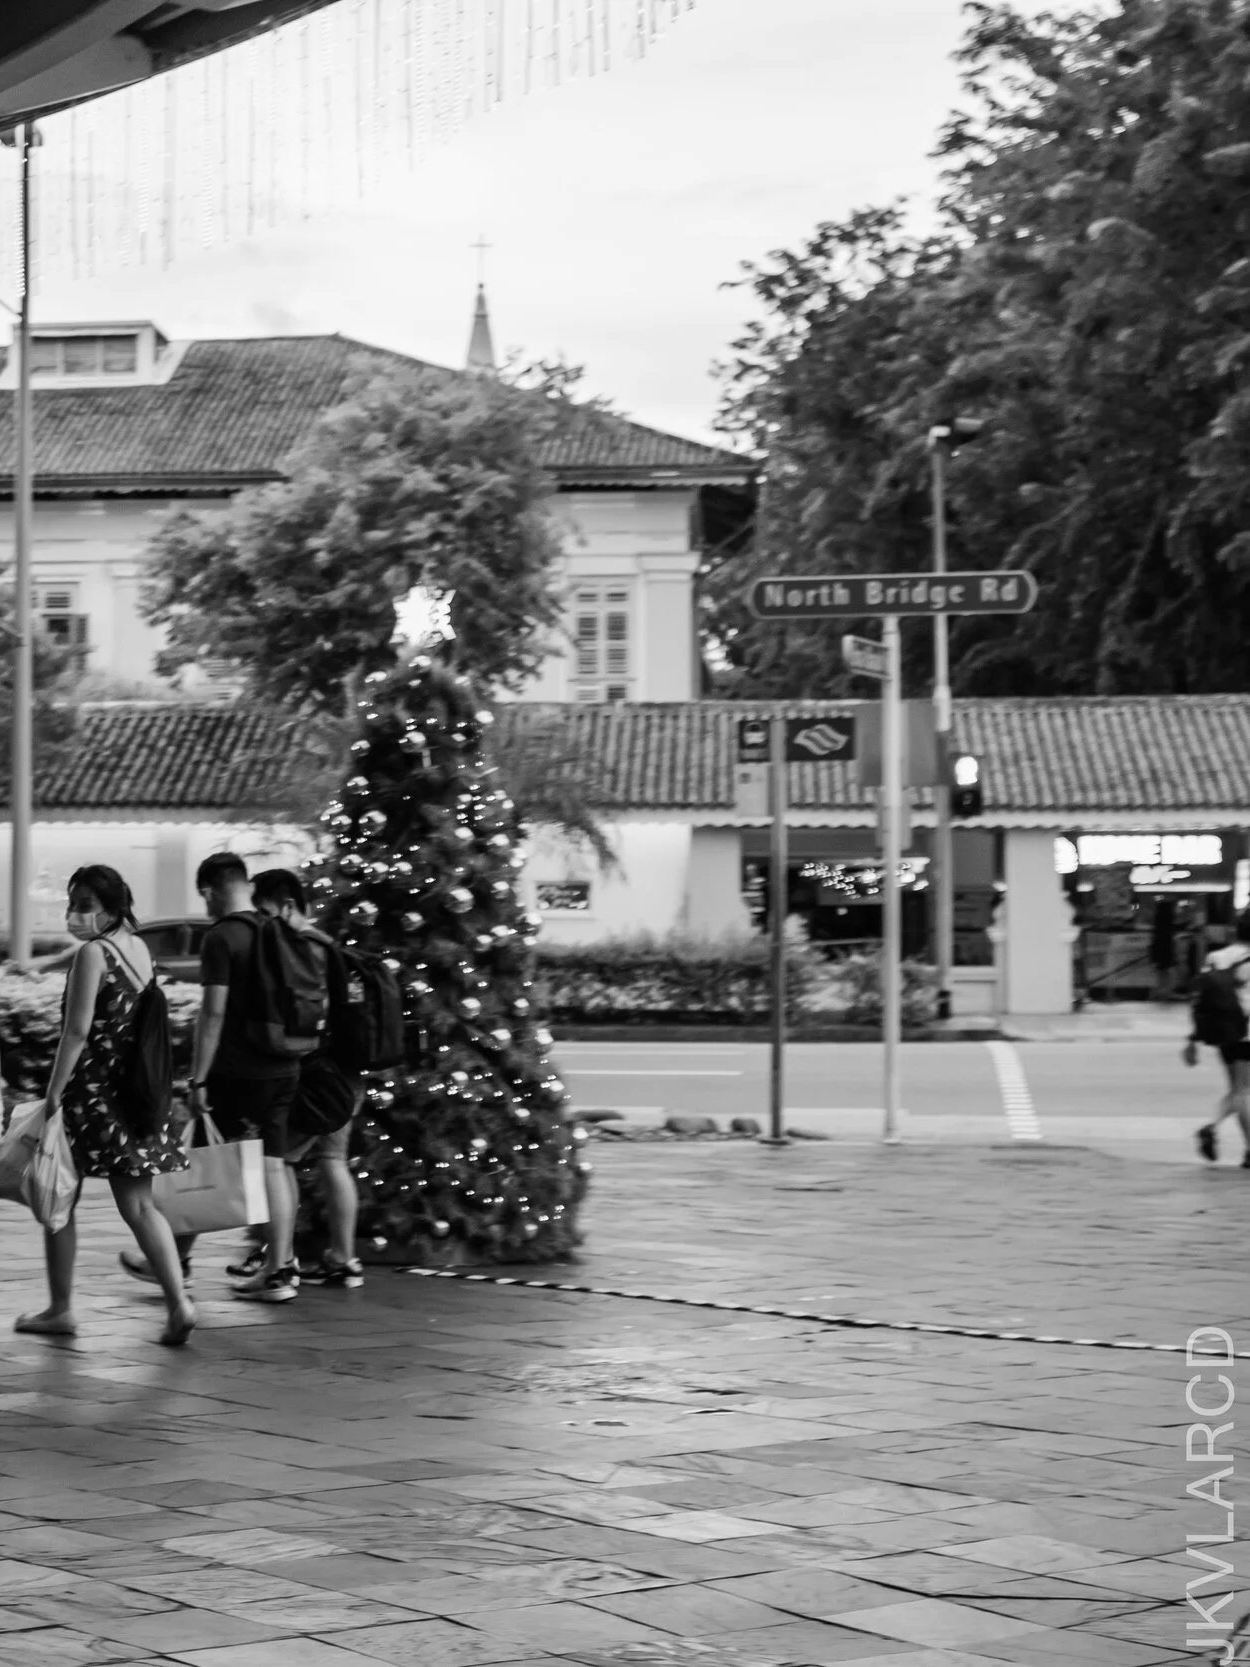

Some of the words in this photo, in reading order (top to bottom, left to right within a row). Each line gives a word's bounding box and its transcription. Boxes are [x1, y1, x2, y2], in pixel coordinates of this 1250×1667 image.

[764, 583, 850, 607] North
[865, 580, 966, 609] Bridge
[980, 578, 1018, 601] Rd
